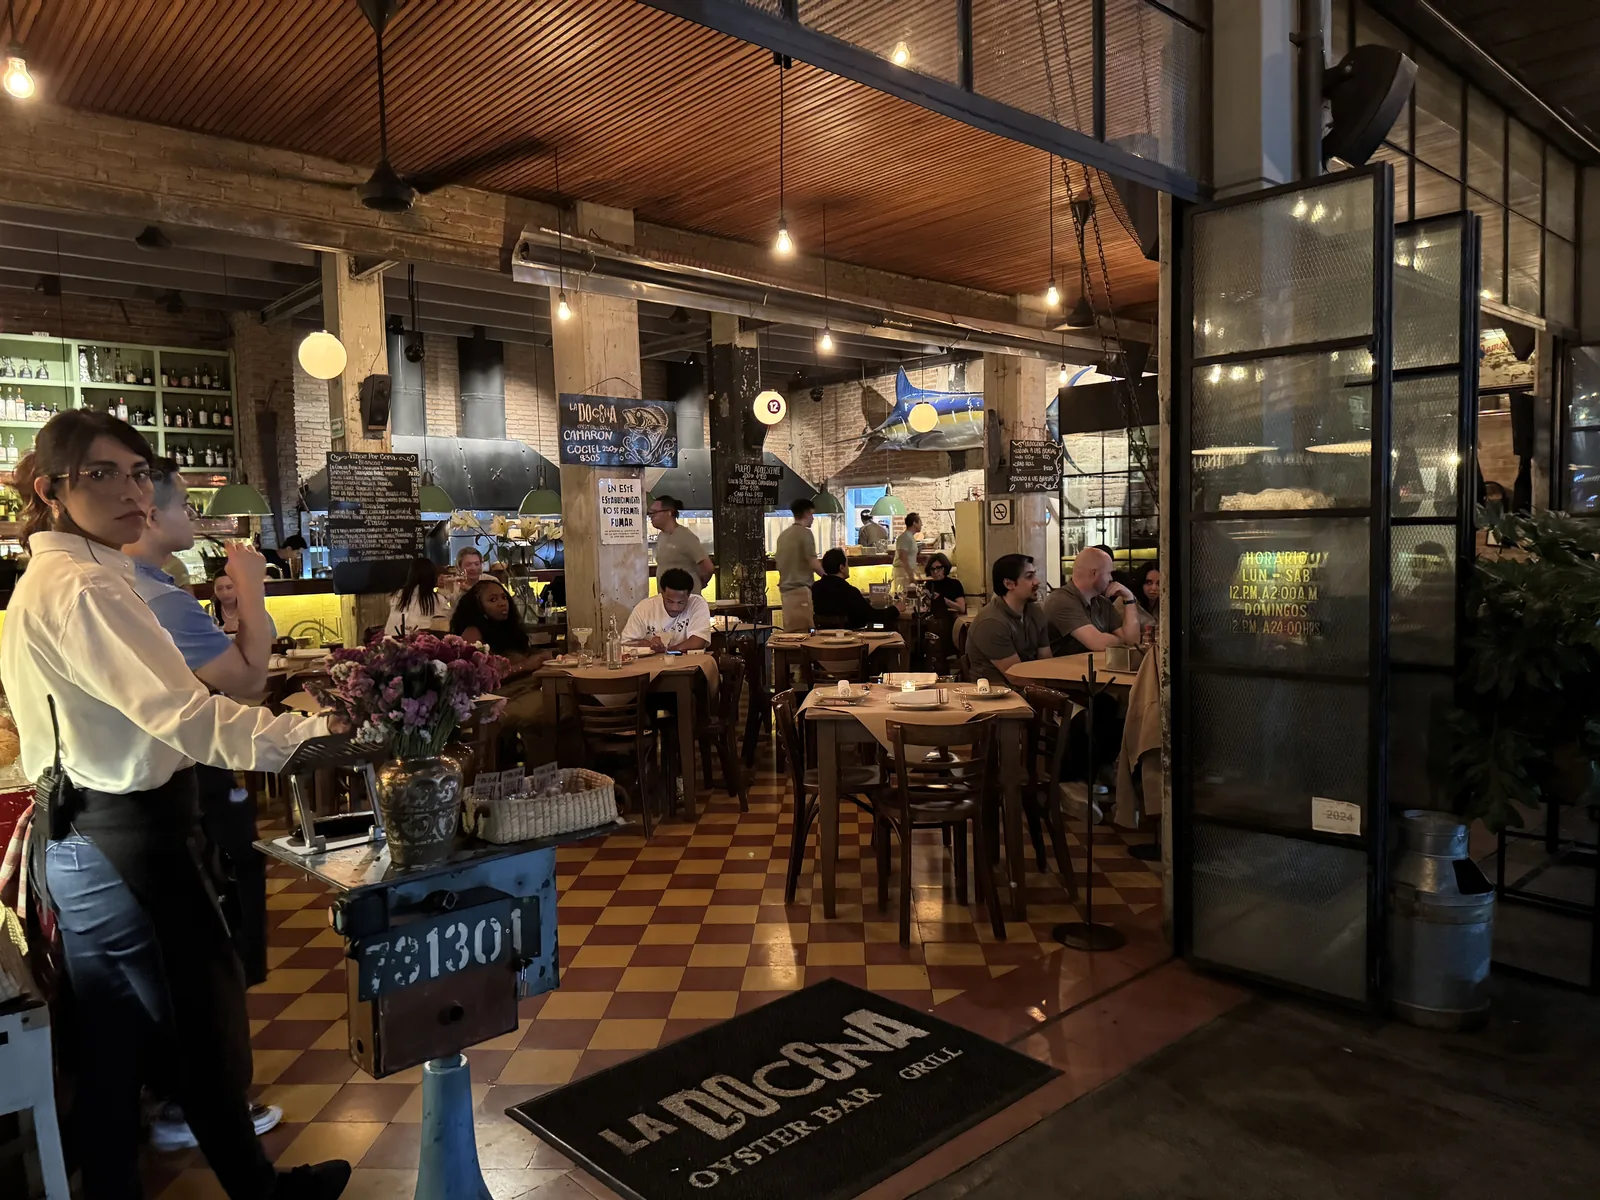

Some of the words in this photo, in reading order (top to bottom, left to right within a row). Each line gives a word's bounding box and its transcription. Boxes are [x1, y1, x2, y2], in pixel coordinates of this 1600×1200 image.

[569, 402, 578, 411] LA
[769, 401, 779, 412] 12
[607, 484, 617, 493] EN
[619, 484, 634, 493] ESTE
[603, 506, 613, 515] NO
[613, 506, 619, 515] SE
[611, 518, 634, 527] FUMAR
[1246, 551, 1308, 565] HORARIO
[1242, 568, 1267, 582] LUN
[1285, 568, 1311, 583] SAB
[1244, 602, 1308, 618] DOMINGOS
[1325, 809, 1354, 823] 2024
[598, 1113, 679, 1155] LA
[657, 1008, 930, 1141] DOCENA
[688, 1118, 821, 1189] OYSTER
[811, 1086, 882, 1125] BAR
[899, 1046, 963, 1081] GRILL
